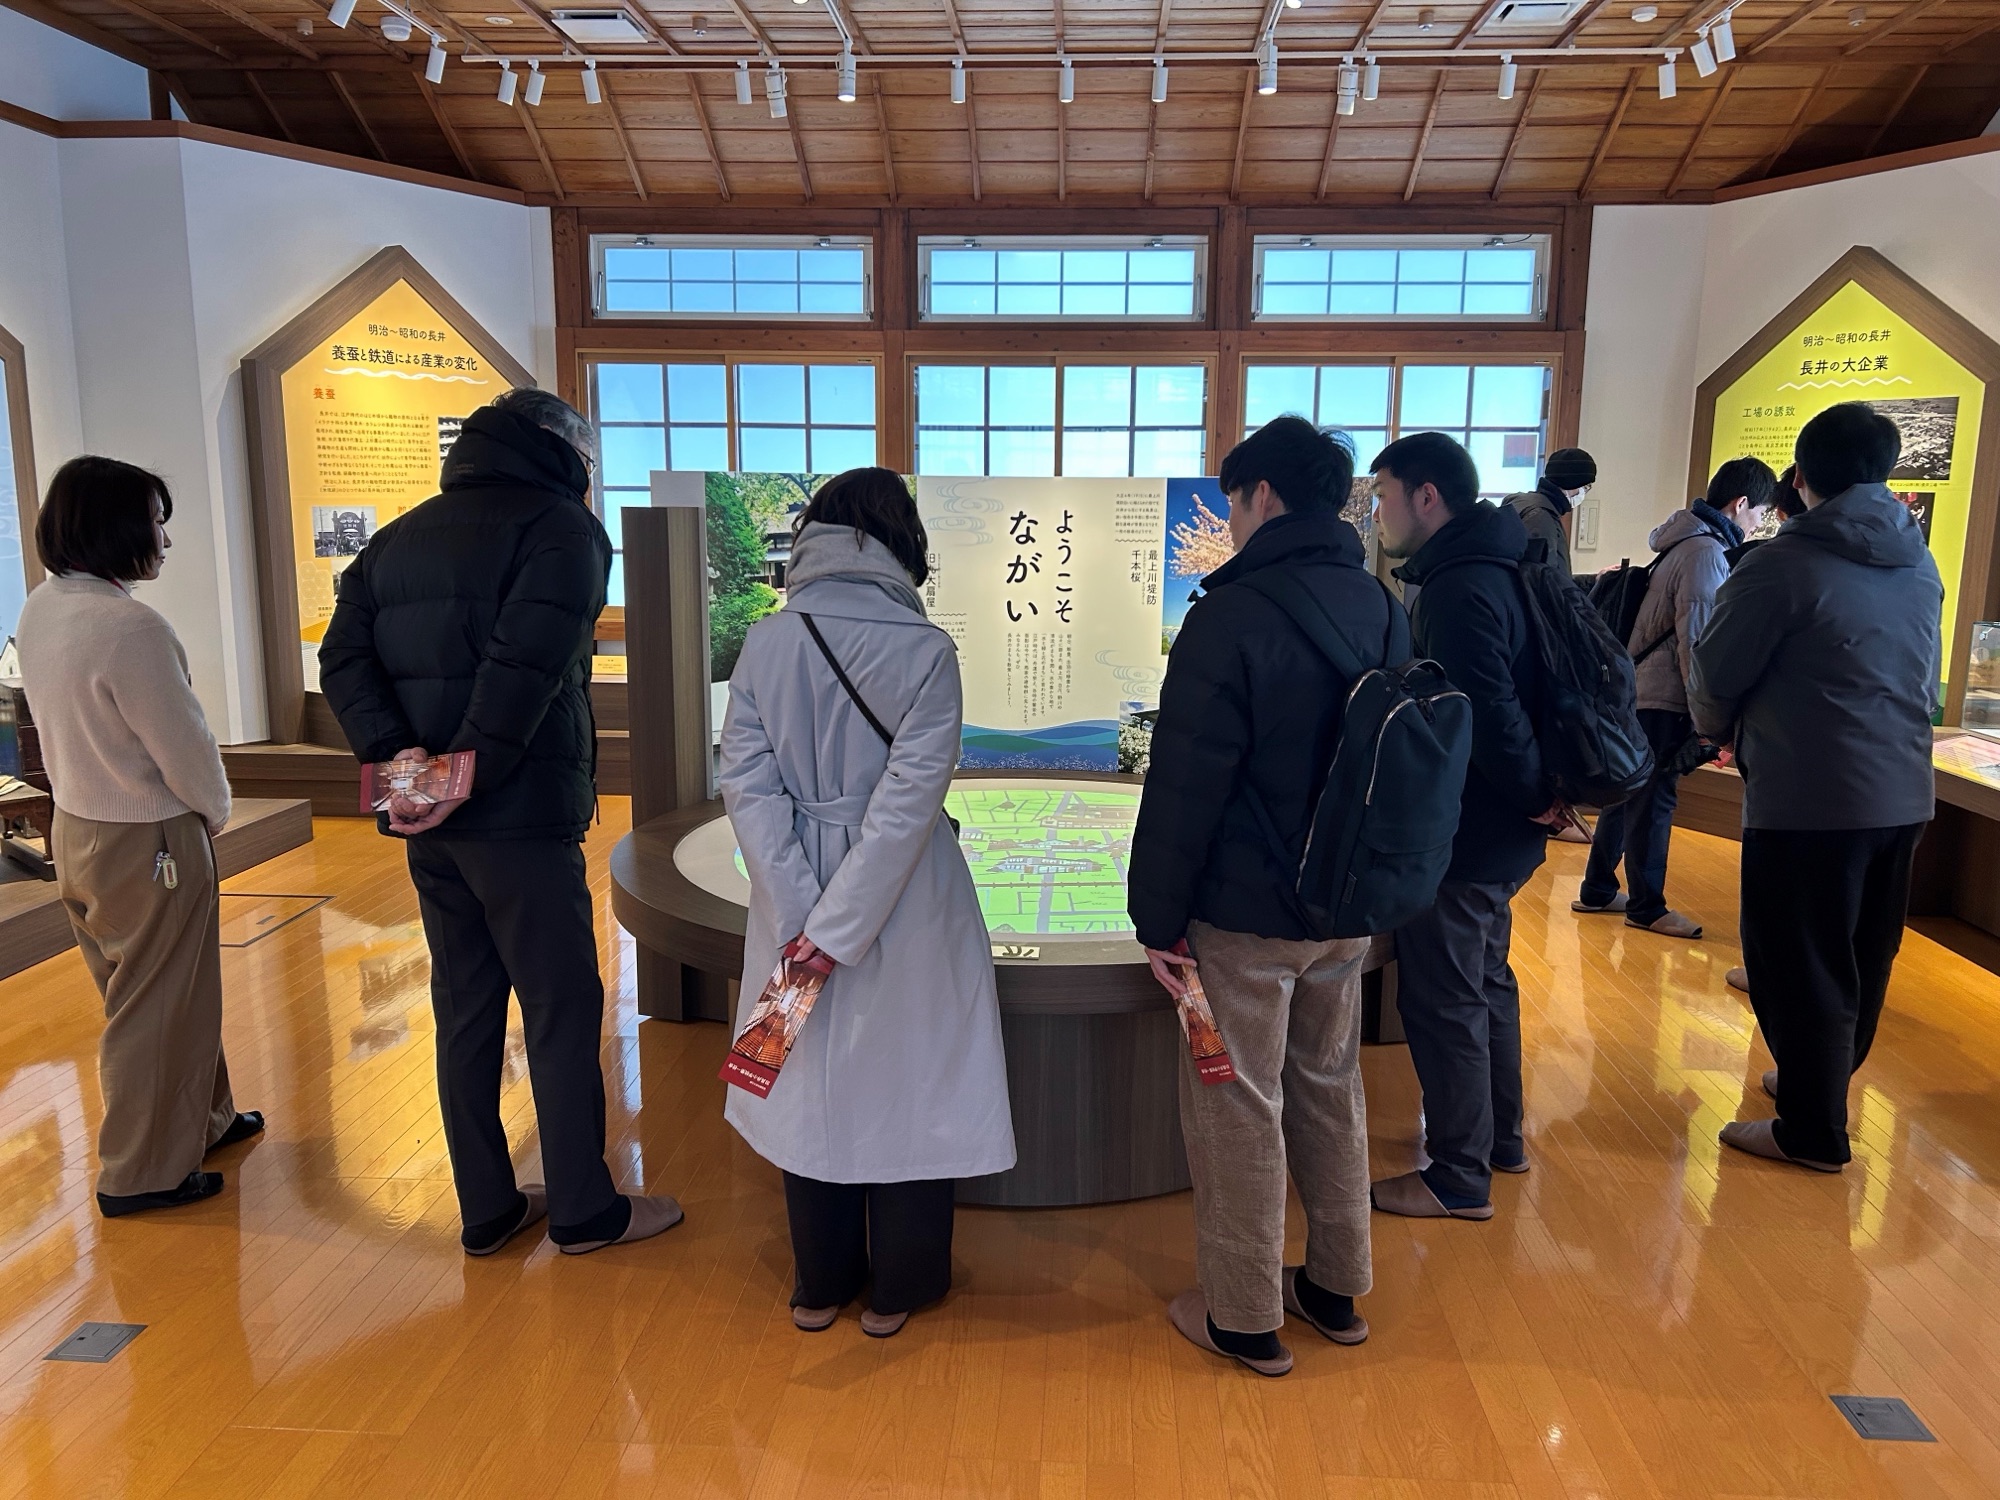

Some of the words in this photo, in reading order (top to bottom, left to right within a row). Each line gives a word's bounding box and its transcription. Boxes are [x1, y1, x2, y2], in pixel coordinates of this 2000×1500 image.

[368, 323, 446, 342] 明治～昭和の長井
[1803, 329, 1891, 347] 明治～昭和の長井
[331, 344, 478, 371] 養蚕と鉄道による産業の変化
[1800, 355, 1888, 376] 長井の大企業
[313, 388, 335, 399] 養蚕
[1742, 406, 1796, 418] 工場の誘致
[1006, 510, 1043, 622] ながい
[1055, 509, 1074, 623] ようこそ
[1131, 550, 1141, 582] 千本桜
[1147, 549, 1158, 605] 最上川堤防
